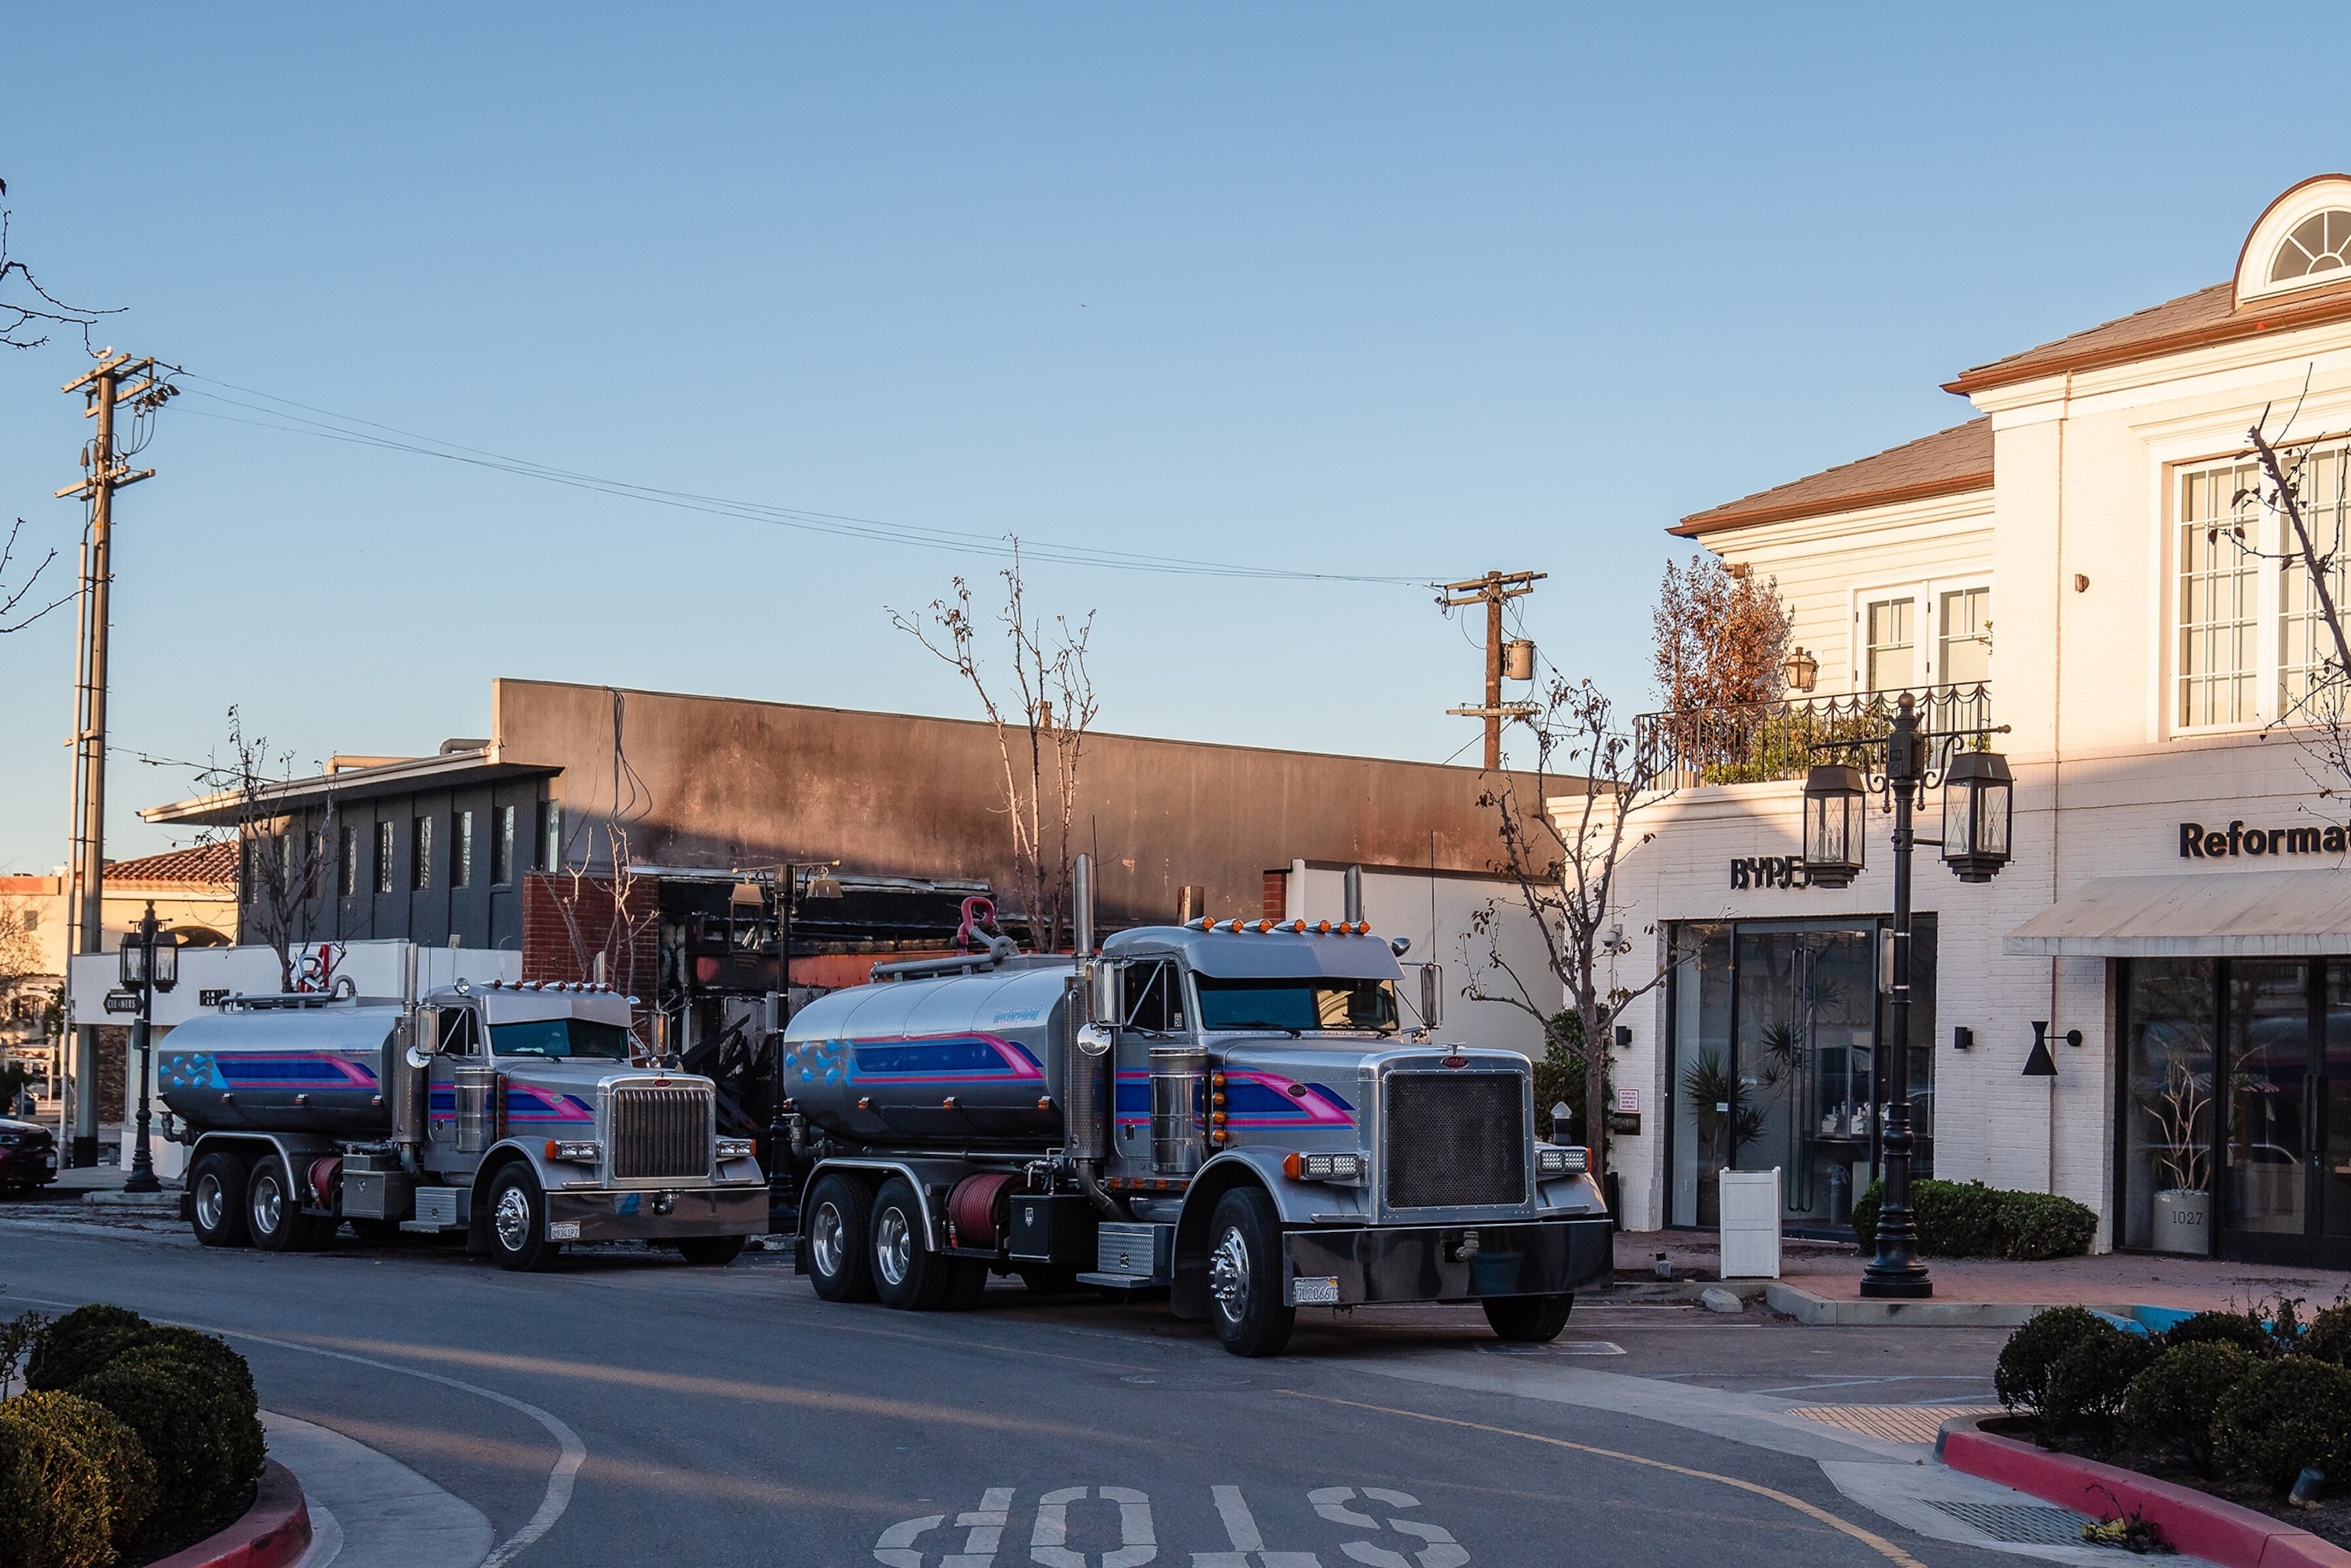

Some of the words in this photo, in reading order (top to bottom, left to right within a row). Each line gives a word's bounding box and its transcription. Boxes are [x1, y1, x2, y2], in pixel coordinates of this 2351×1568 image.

[2180, 820, 2351, 858] Reforma
[1730, 855, 1813, 890] BYRE
[2172, 1211, 2203, 1225] 1027
[1296, 1286, 1335, 1300] 7L20667
[872, 1485, 1471, 1568] STOP
